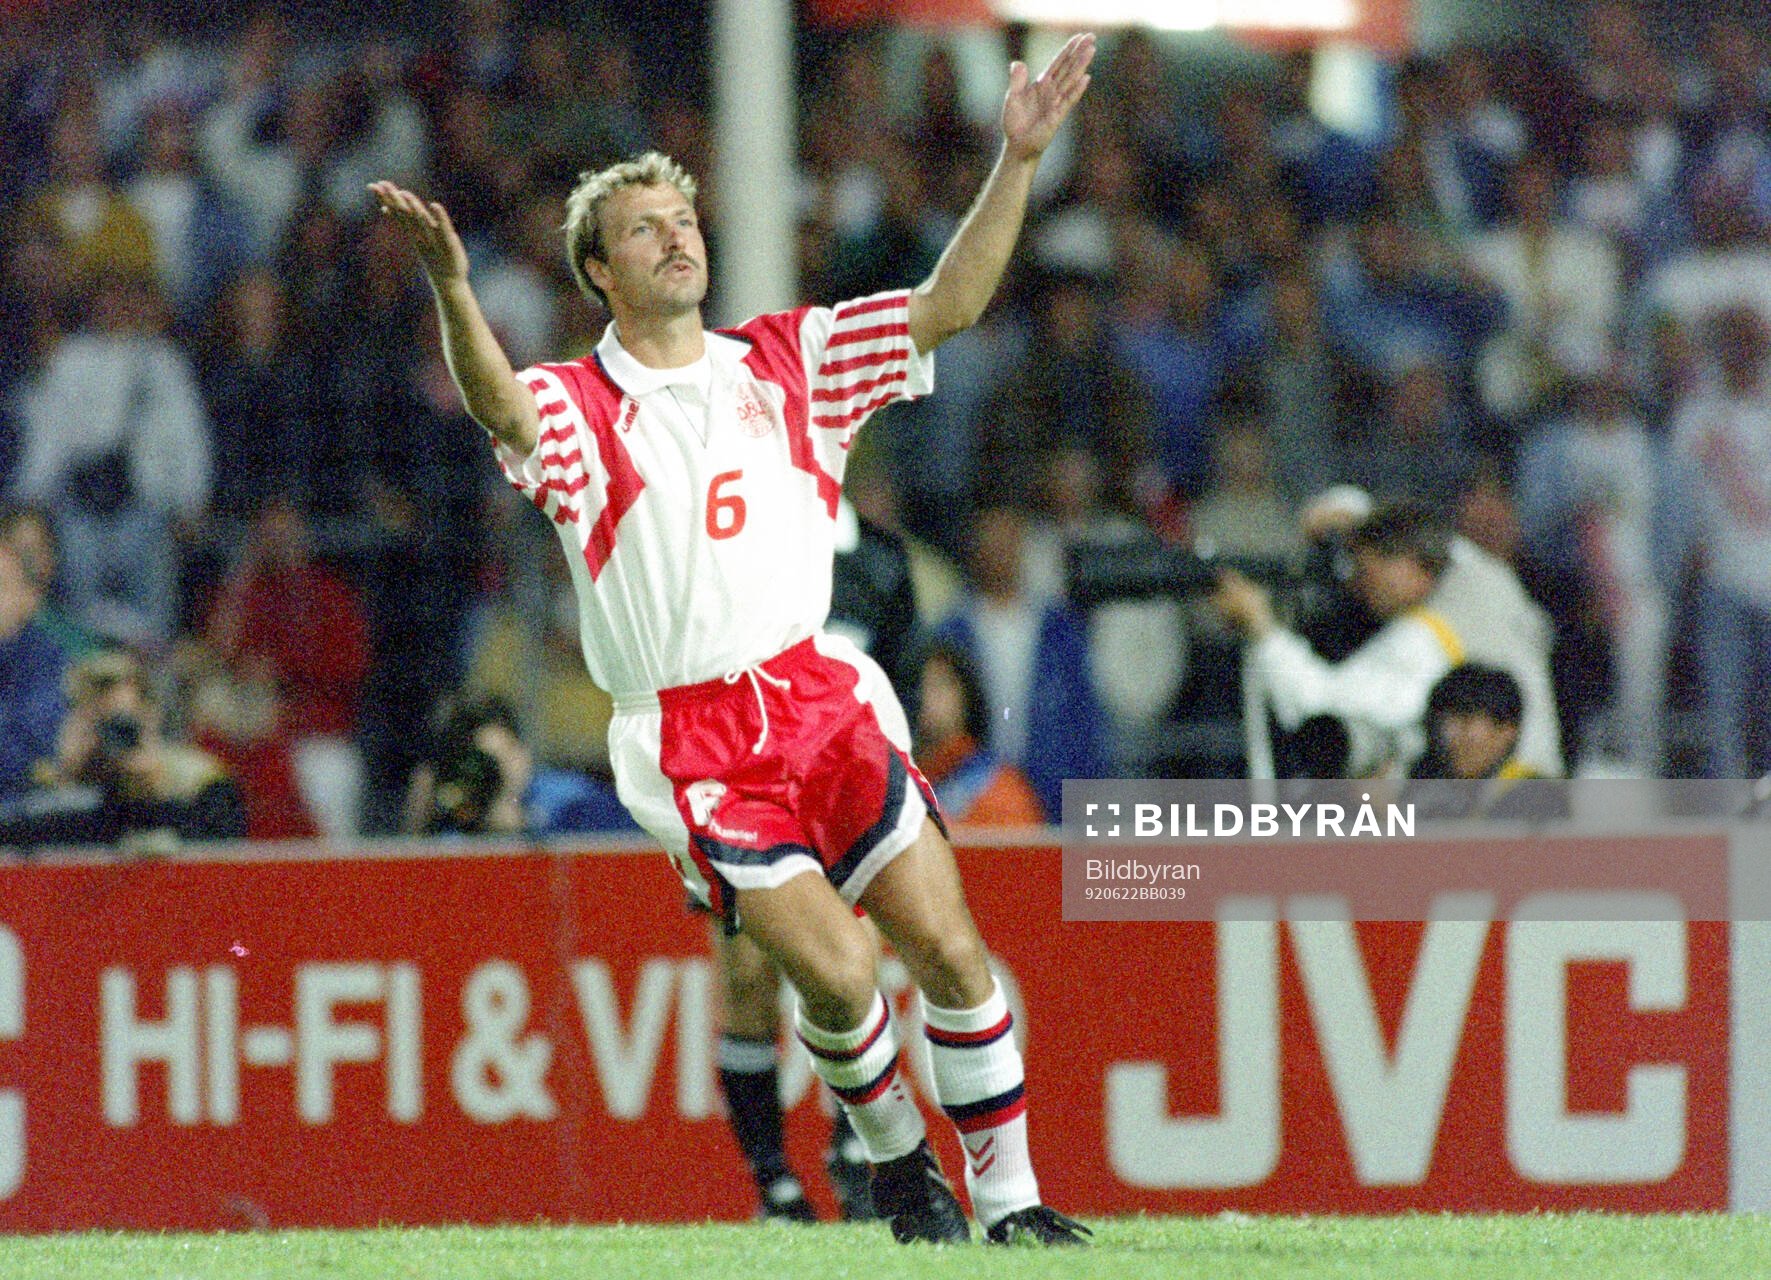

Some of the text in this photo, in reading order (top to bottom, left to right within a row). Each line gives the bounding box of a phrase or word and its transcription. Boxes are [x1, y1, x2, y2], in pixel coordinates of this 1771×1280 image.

[705, 469, 747, 540] 6
[102, 960, 424, 1127] HI-FI
[450, 958, 557, 1124] &
[1105, 892, 1689, 1190] JVC
